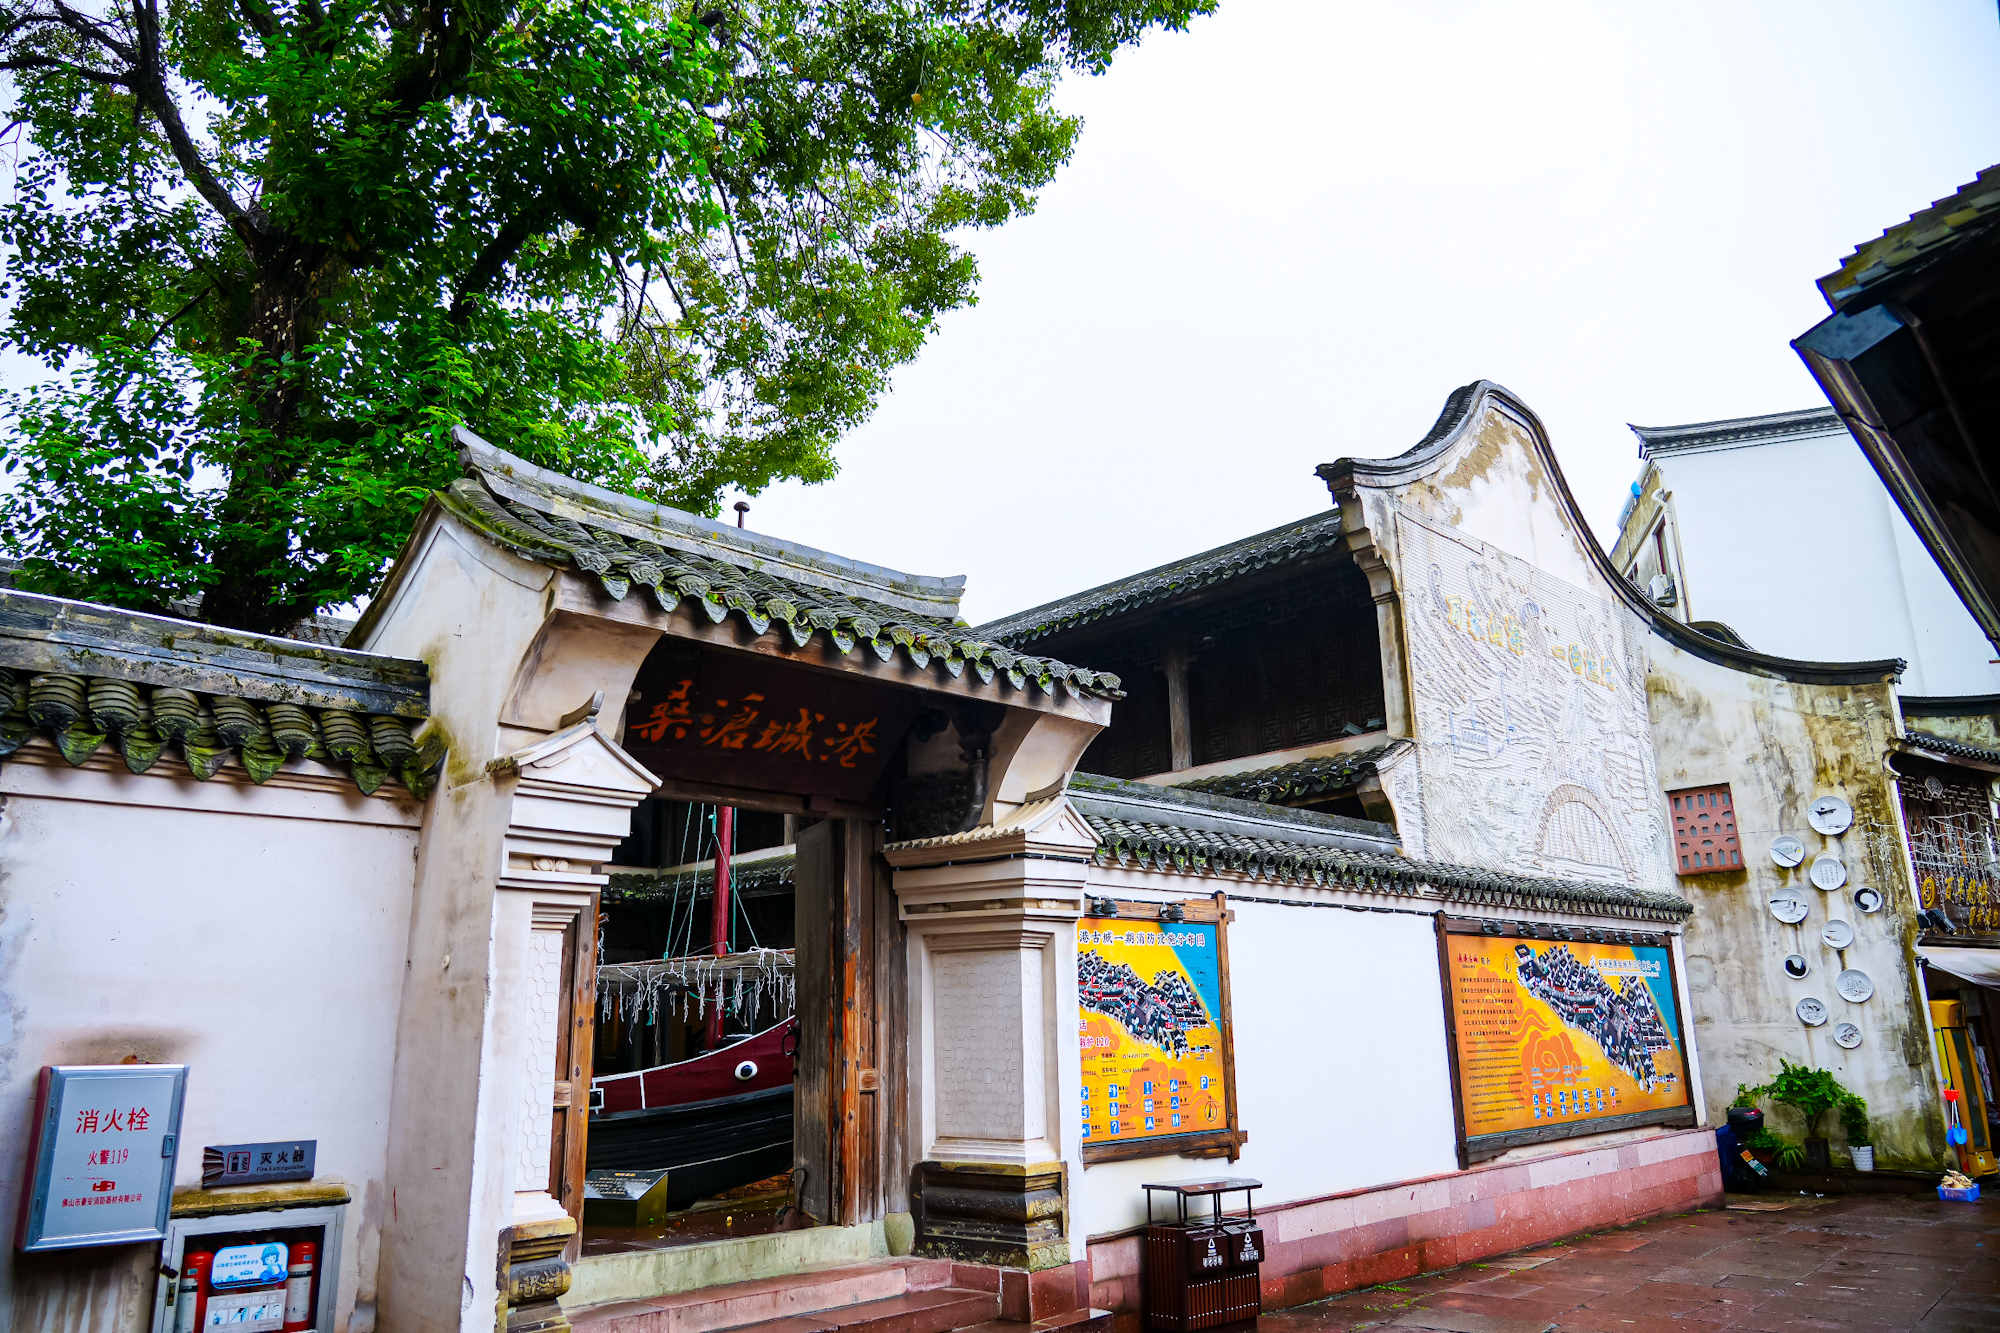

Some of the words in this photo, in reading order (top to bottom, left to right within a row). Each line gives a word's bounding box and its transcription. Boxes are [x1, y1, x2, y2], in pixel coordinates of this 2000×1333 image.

[75, 1107, 150, 1134] 消火栓
[87, 1149, 129, 1166] 火警119
[259, 1149, 305, 1165] 灭火器
[269, 1164, 306, 1172] Extinguisher
[217, 1295, 278, 1308] 灭火器使用方法
